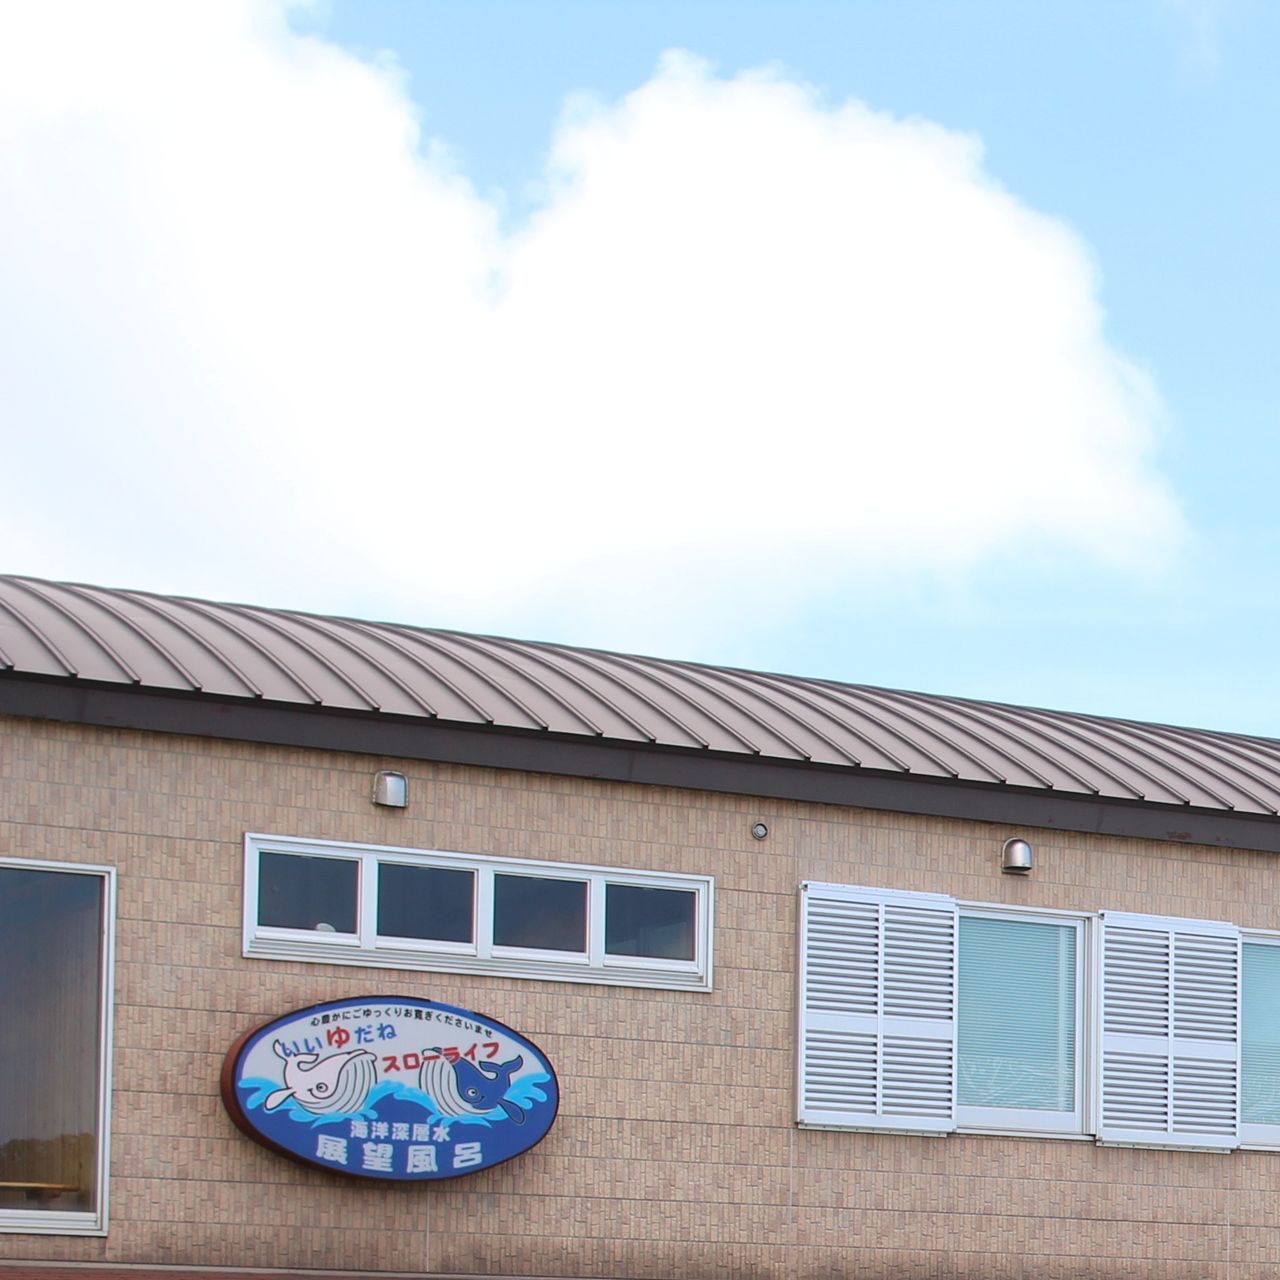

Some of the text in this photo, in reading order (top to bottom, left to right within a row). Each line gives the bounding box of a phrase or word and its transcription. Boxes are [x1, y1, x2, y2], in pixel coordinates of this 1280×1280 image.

[281, 1022, 397, 1058] いいゆだね
[382, 1041, 500, 1073] スローライフ
[350, 1120, 451, 1142] 海洋深層水
[315, 1133, 483, 1174] 展望風呂
